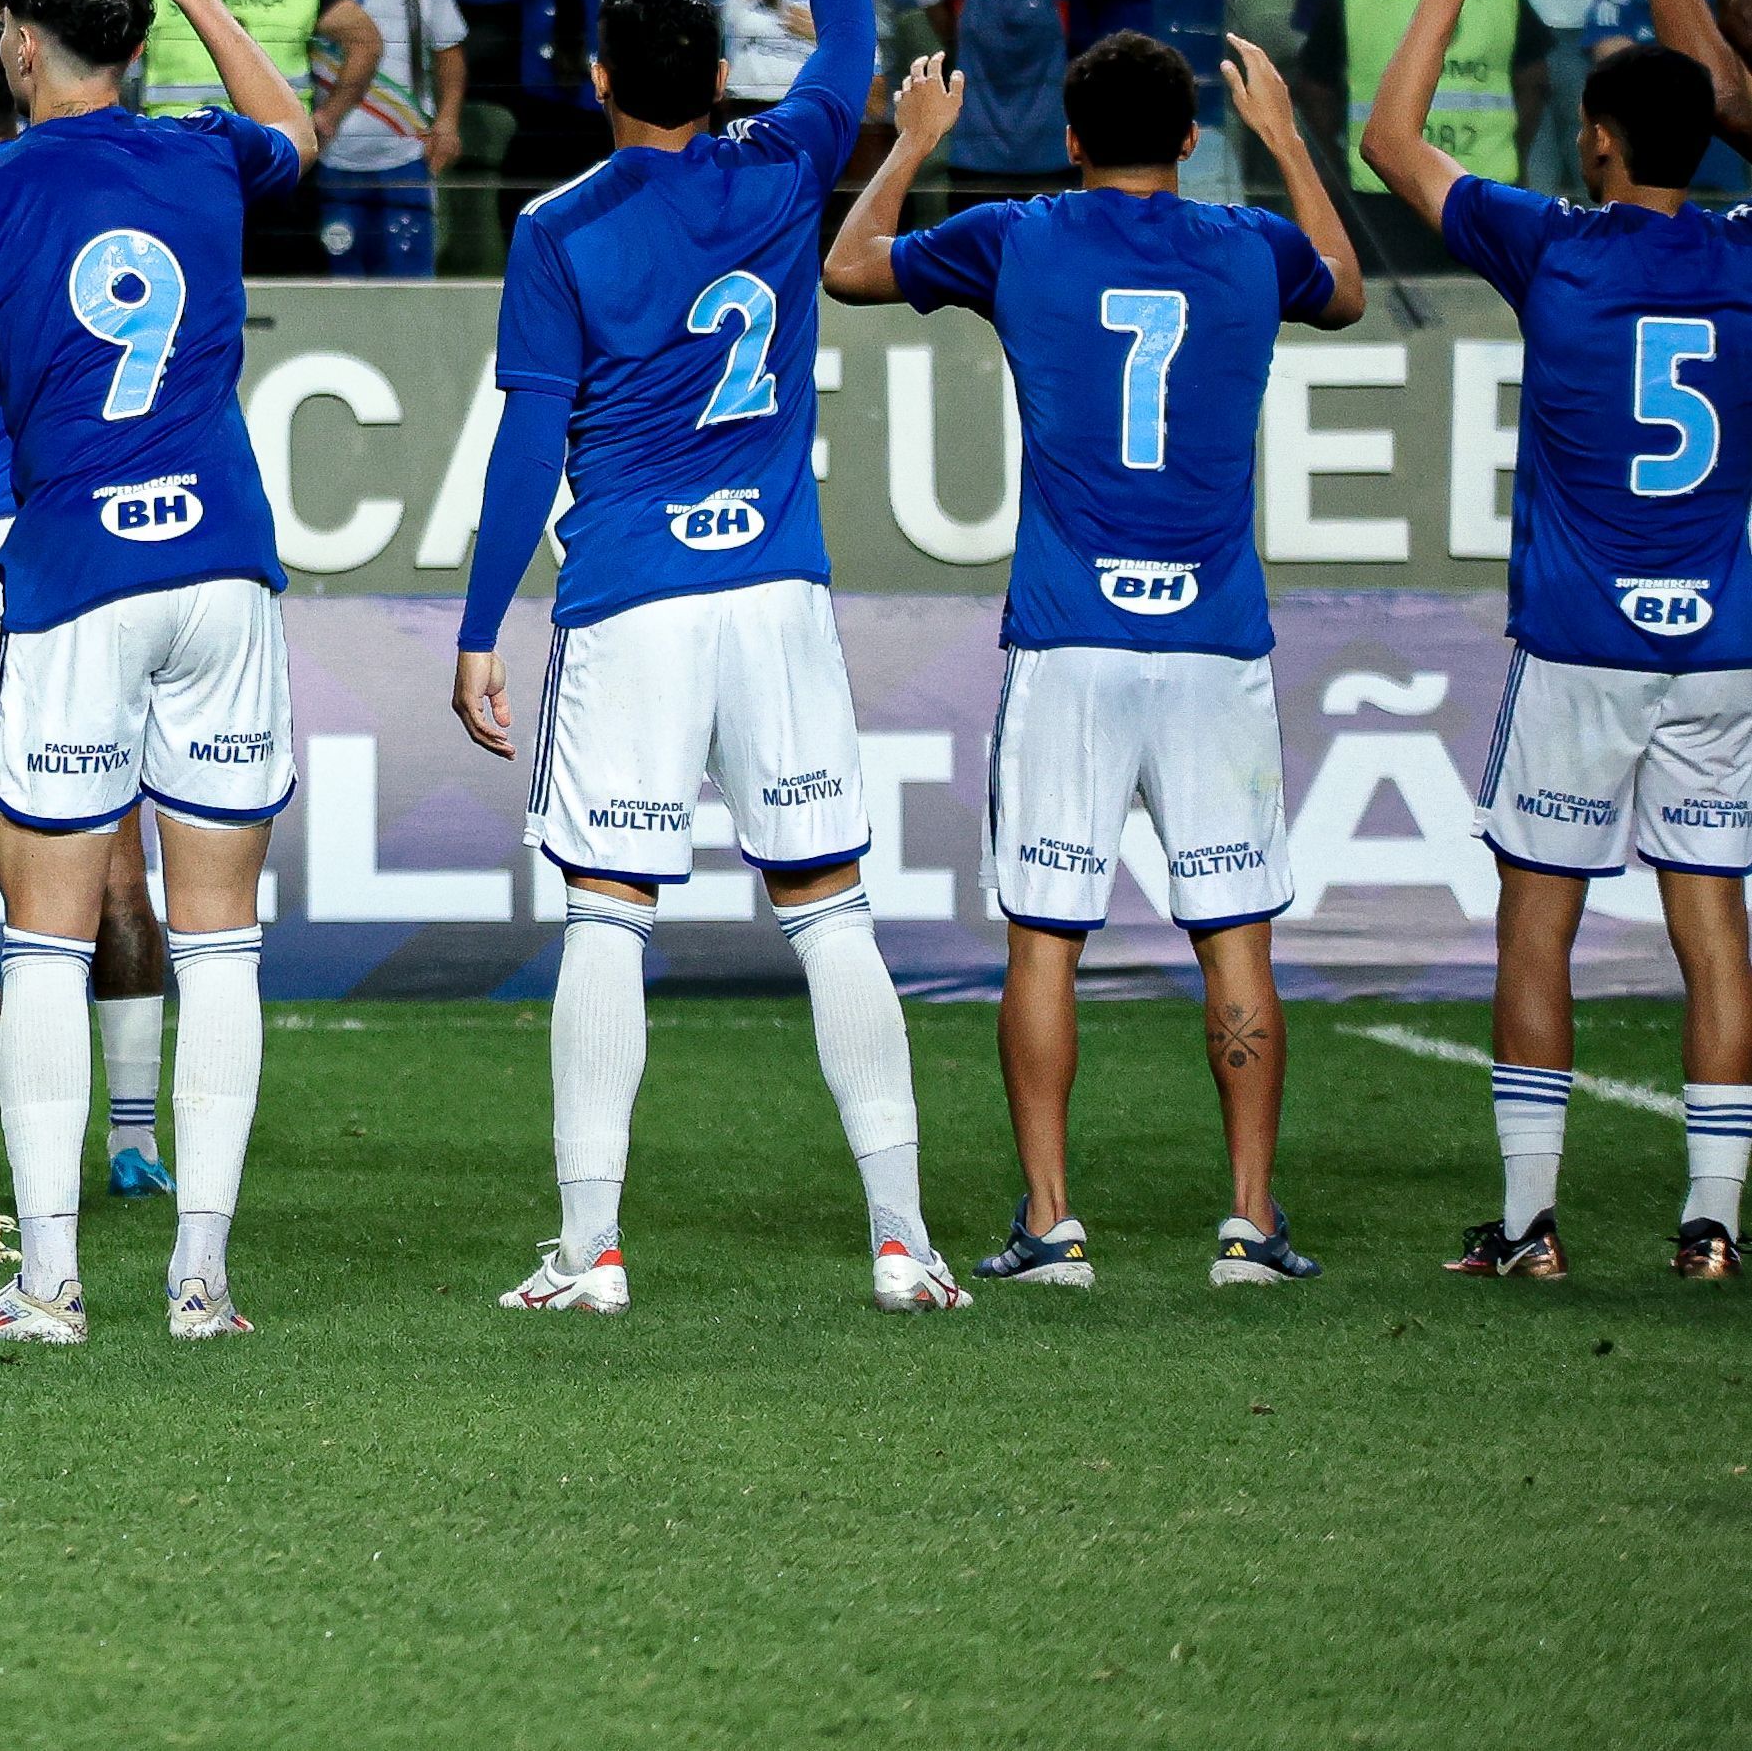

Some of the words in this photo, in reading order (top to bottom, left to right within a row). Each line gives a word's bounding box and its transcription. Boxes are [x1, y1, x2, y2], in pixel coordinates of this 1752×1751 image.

[68, 227, 188, 422] 9
[686, 269, 778, 431] 2
[1100, 288, 1189, 471] 7
[1629, 316, 1723, 498] 5
[92, 473, 198, 500] SUPERMERCADOS
[117, 495, 188, 530] BH
[685, 508, 750, 539] BH
[1112, 574, 1187, 601] BH
[1634, 596, 1698, 625] BH
[27, 748, 131, 774] MULTIVIX
[44, 742, 119, 755] FACULDADE
[762, 778, 844, 807] MULTIVIX
[777, 769, 828, 789] FACULDADE
[610, 799, 684, 812] FACULDADE
[1039, 837, 1093, 856] FACULDA
[1178, 841, 1251, 860] FACULDADE
